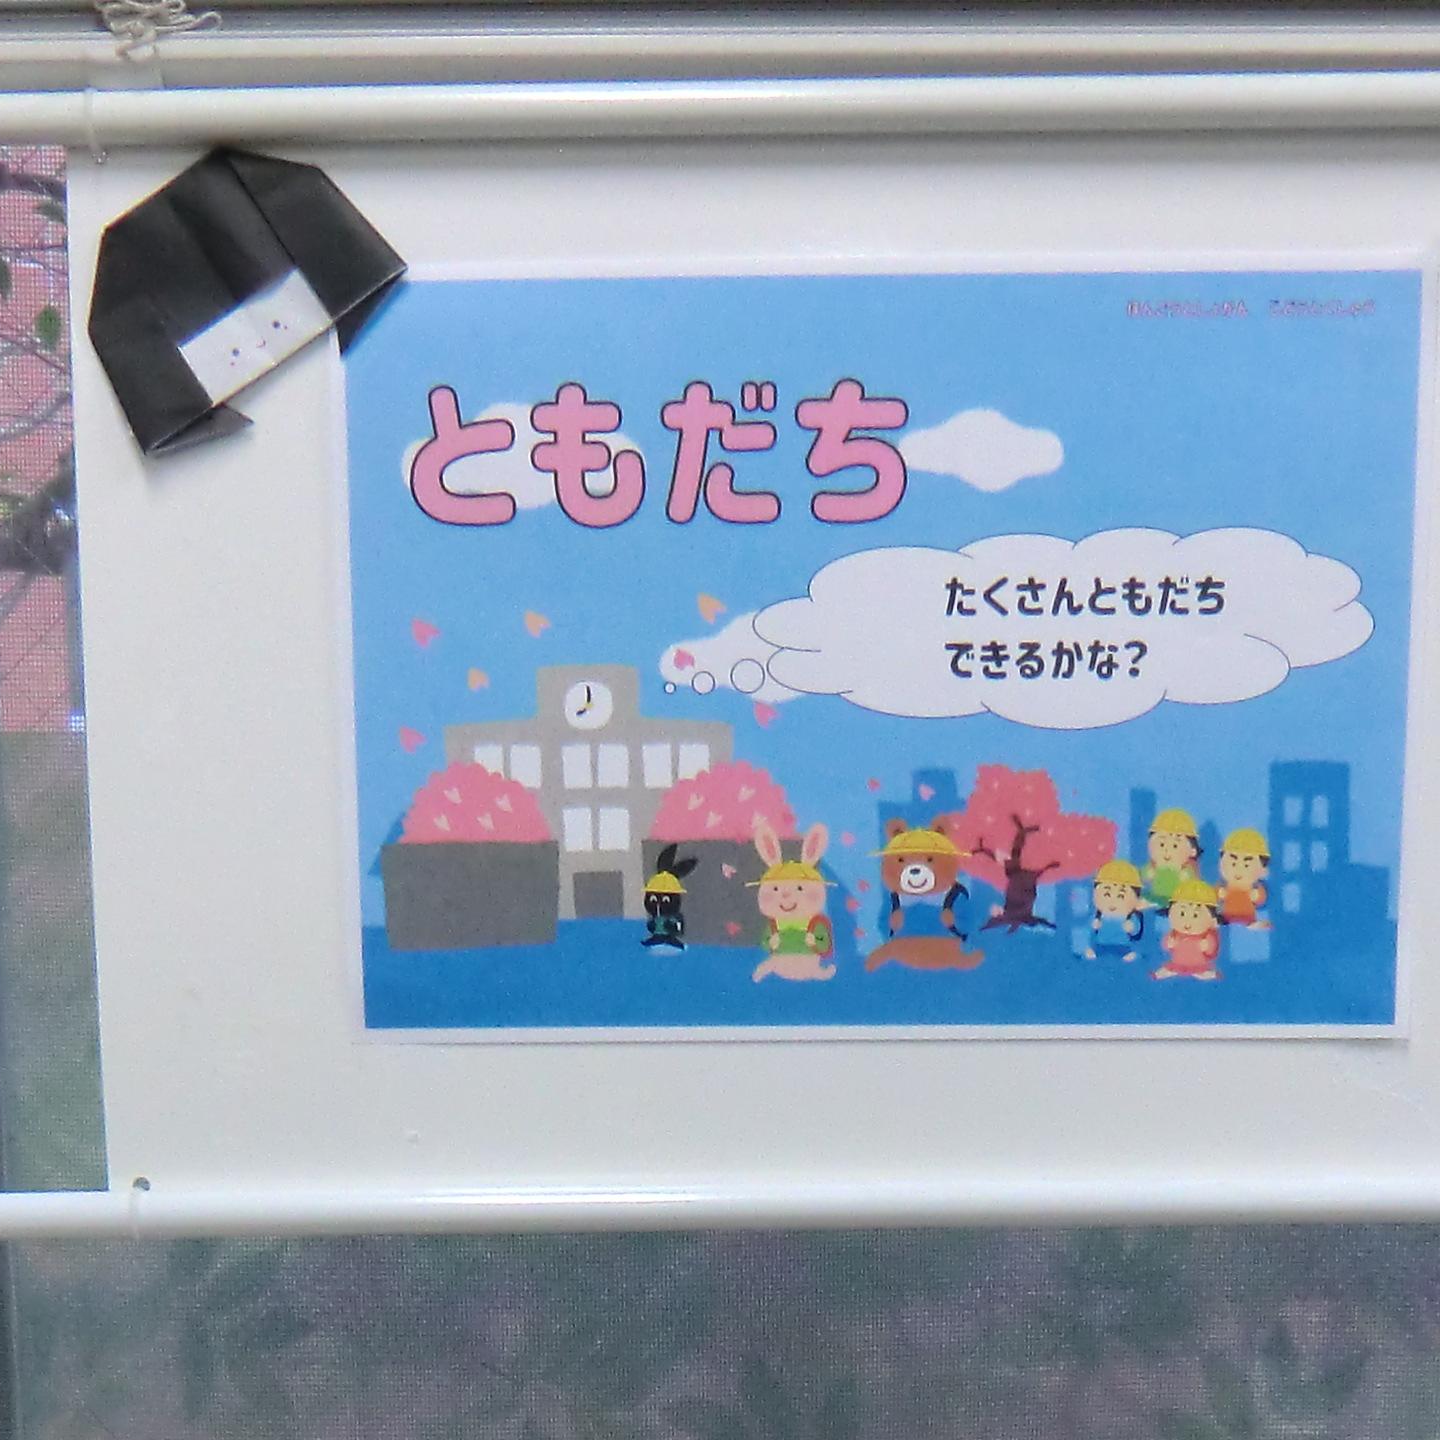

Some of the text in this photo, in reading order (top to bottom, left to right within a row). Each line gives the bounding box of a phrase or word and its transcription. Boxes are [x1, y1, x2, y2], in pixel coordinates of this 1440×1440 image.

[409, 377, 910, 529] ともだち
[944, 576, 1227, 620] たくさんともだち
[944, 639, 1149, 682] できるかな?
